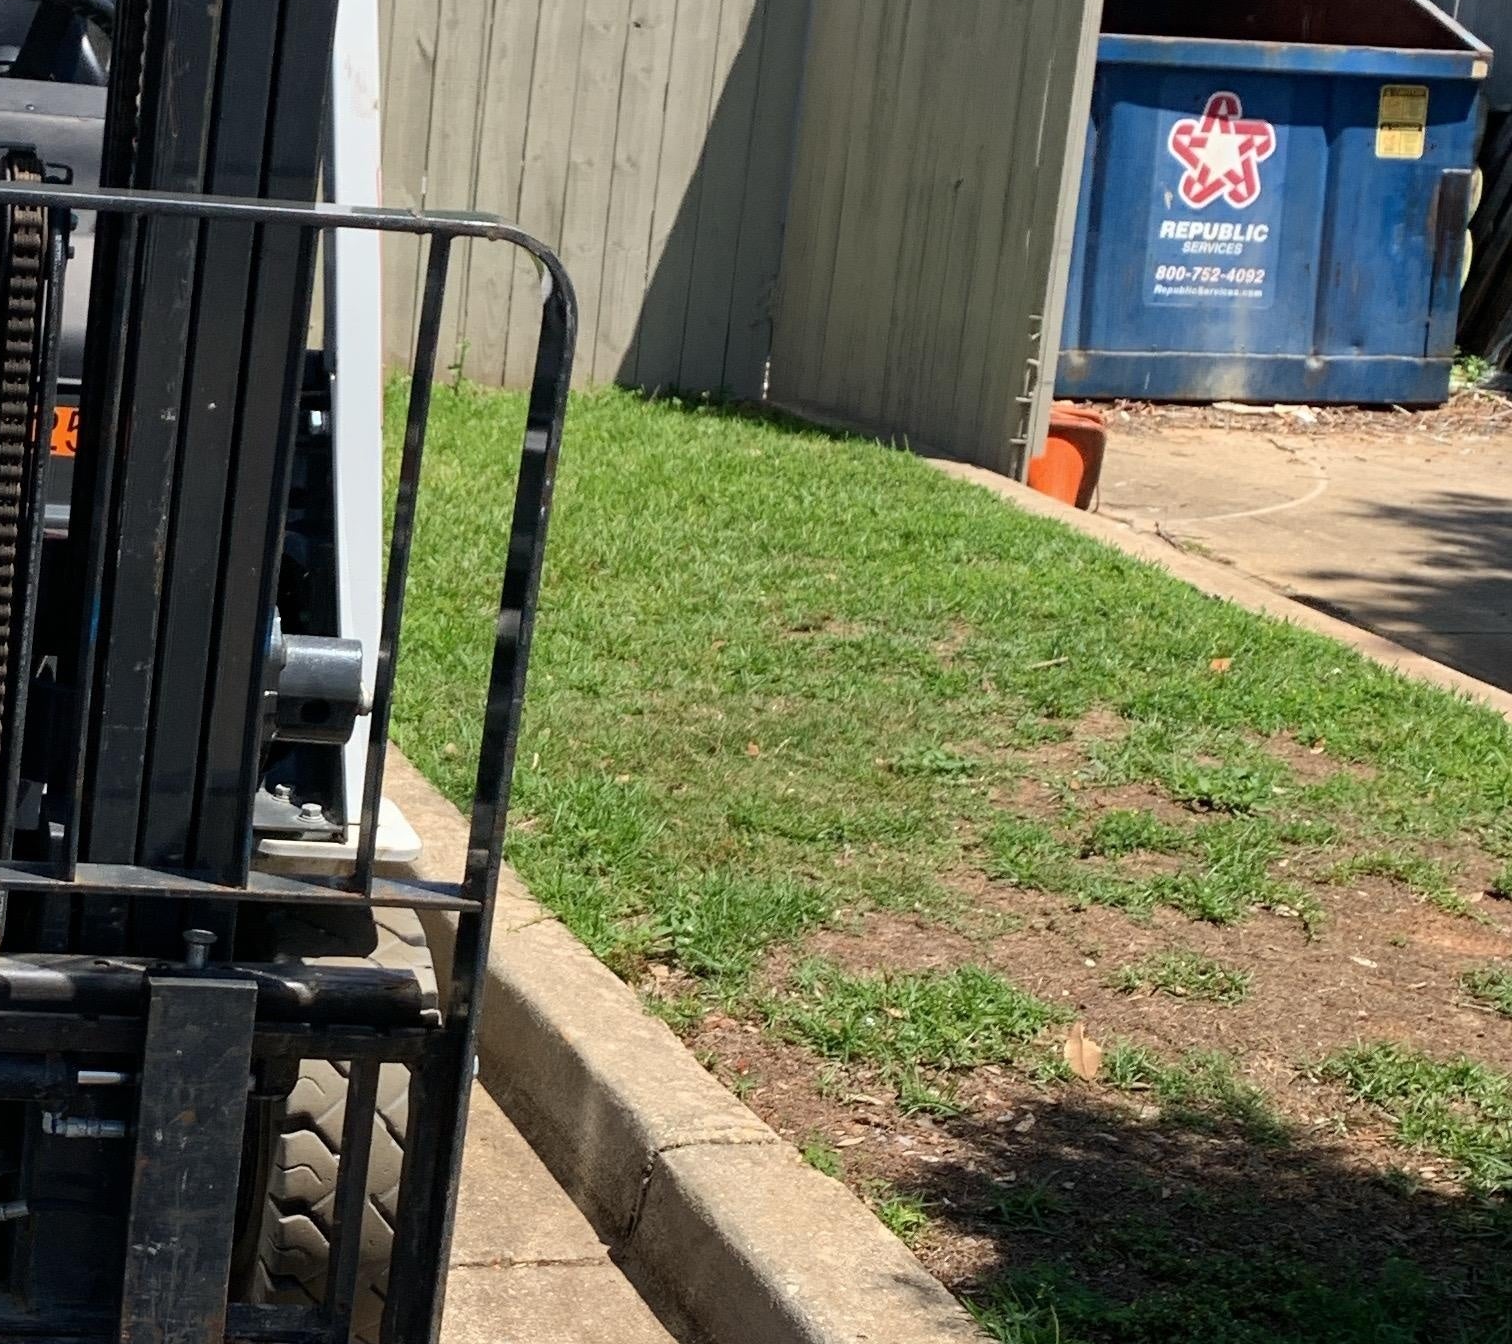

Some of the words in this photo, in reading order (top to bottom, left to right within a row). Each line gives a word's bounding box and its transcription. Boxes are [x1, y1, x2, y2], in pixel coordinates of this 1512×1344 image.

[1159, 219, 1269, 243] REPUBLIC
[1181, 240, 1243, 255] SERVICES
[1154, 265, 1265, 284] 800-752-4092
